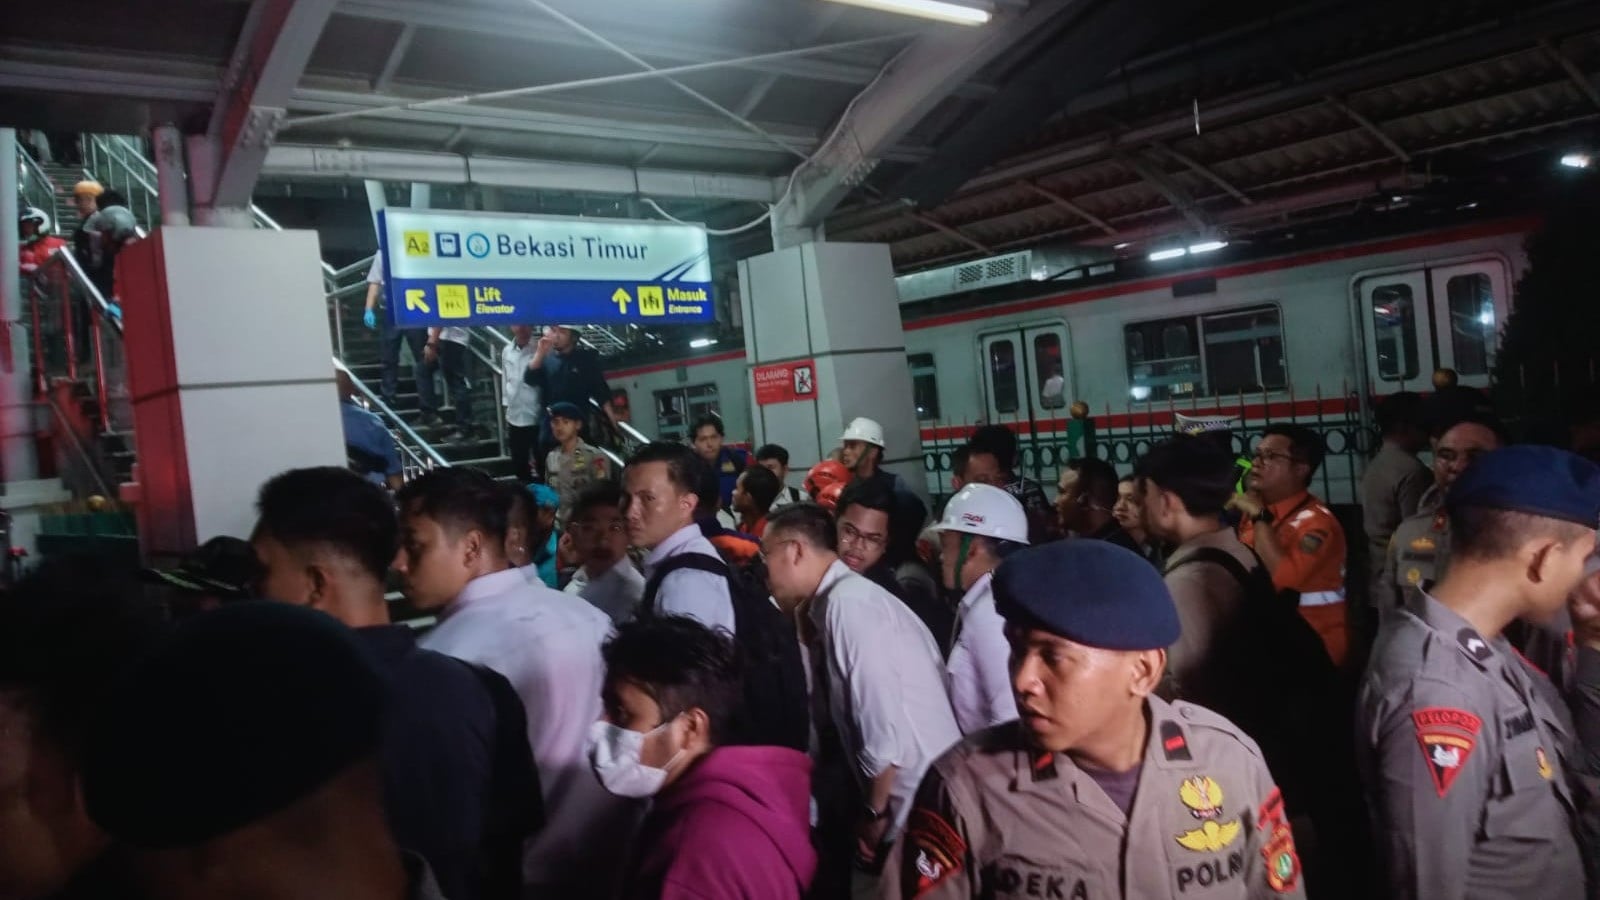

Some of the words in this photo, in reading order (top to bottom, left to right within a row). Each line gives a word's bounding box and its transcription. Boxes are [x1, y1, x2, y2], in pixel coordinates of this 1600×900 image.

[497, 233, 575, 259] Bekasi
[582, 238, 648, 260] Timur
[474, 286, 502, 302] Lift
[667, 287, 708, 302] Masuk
[475, 303, 515, 315] Elevator
[668, 303, 703, 315] Entrance
